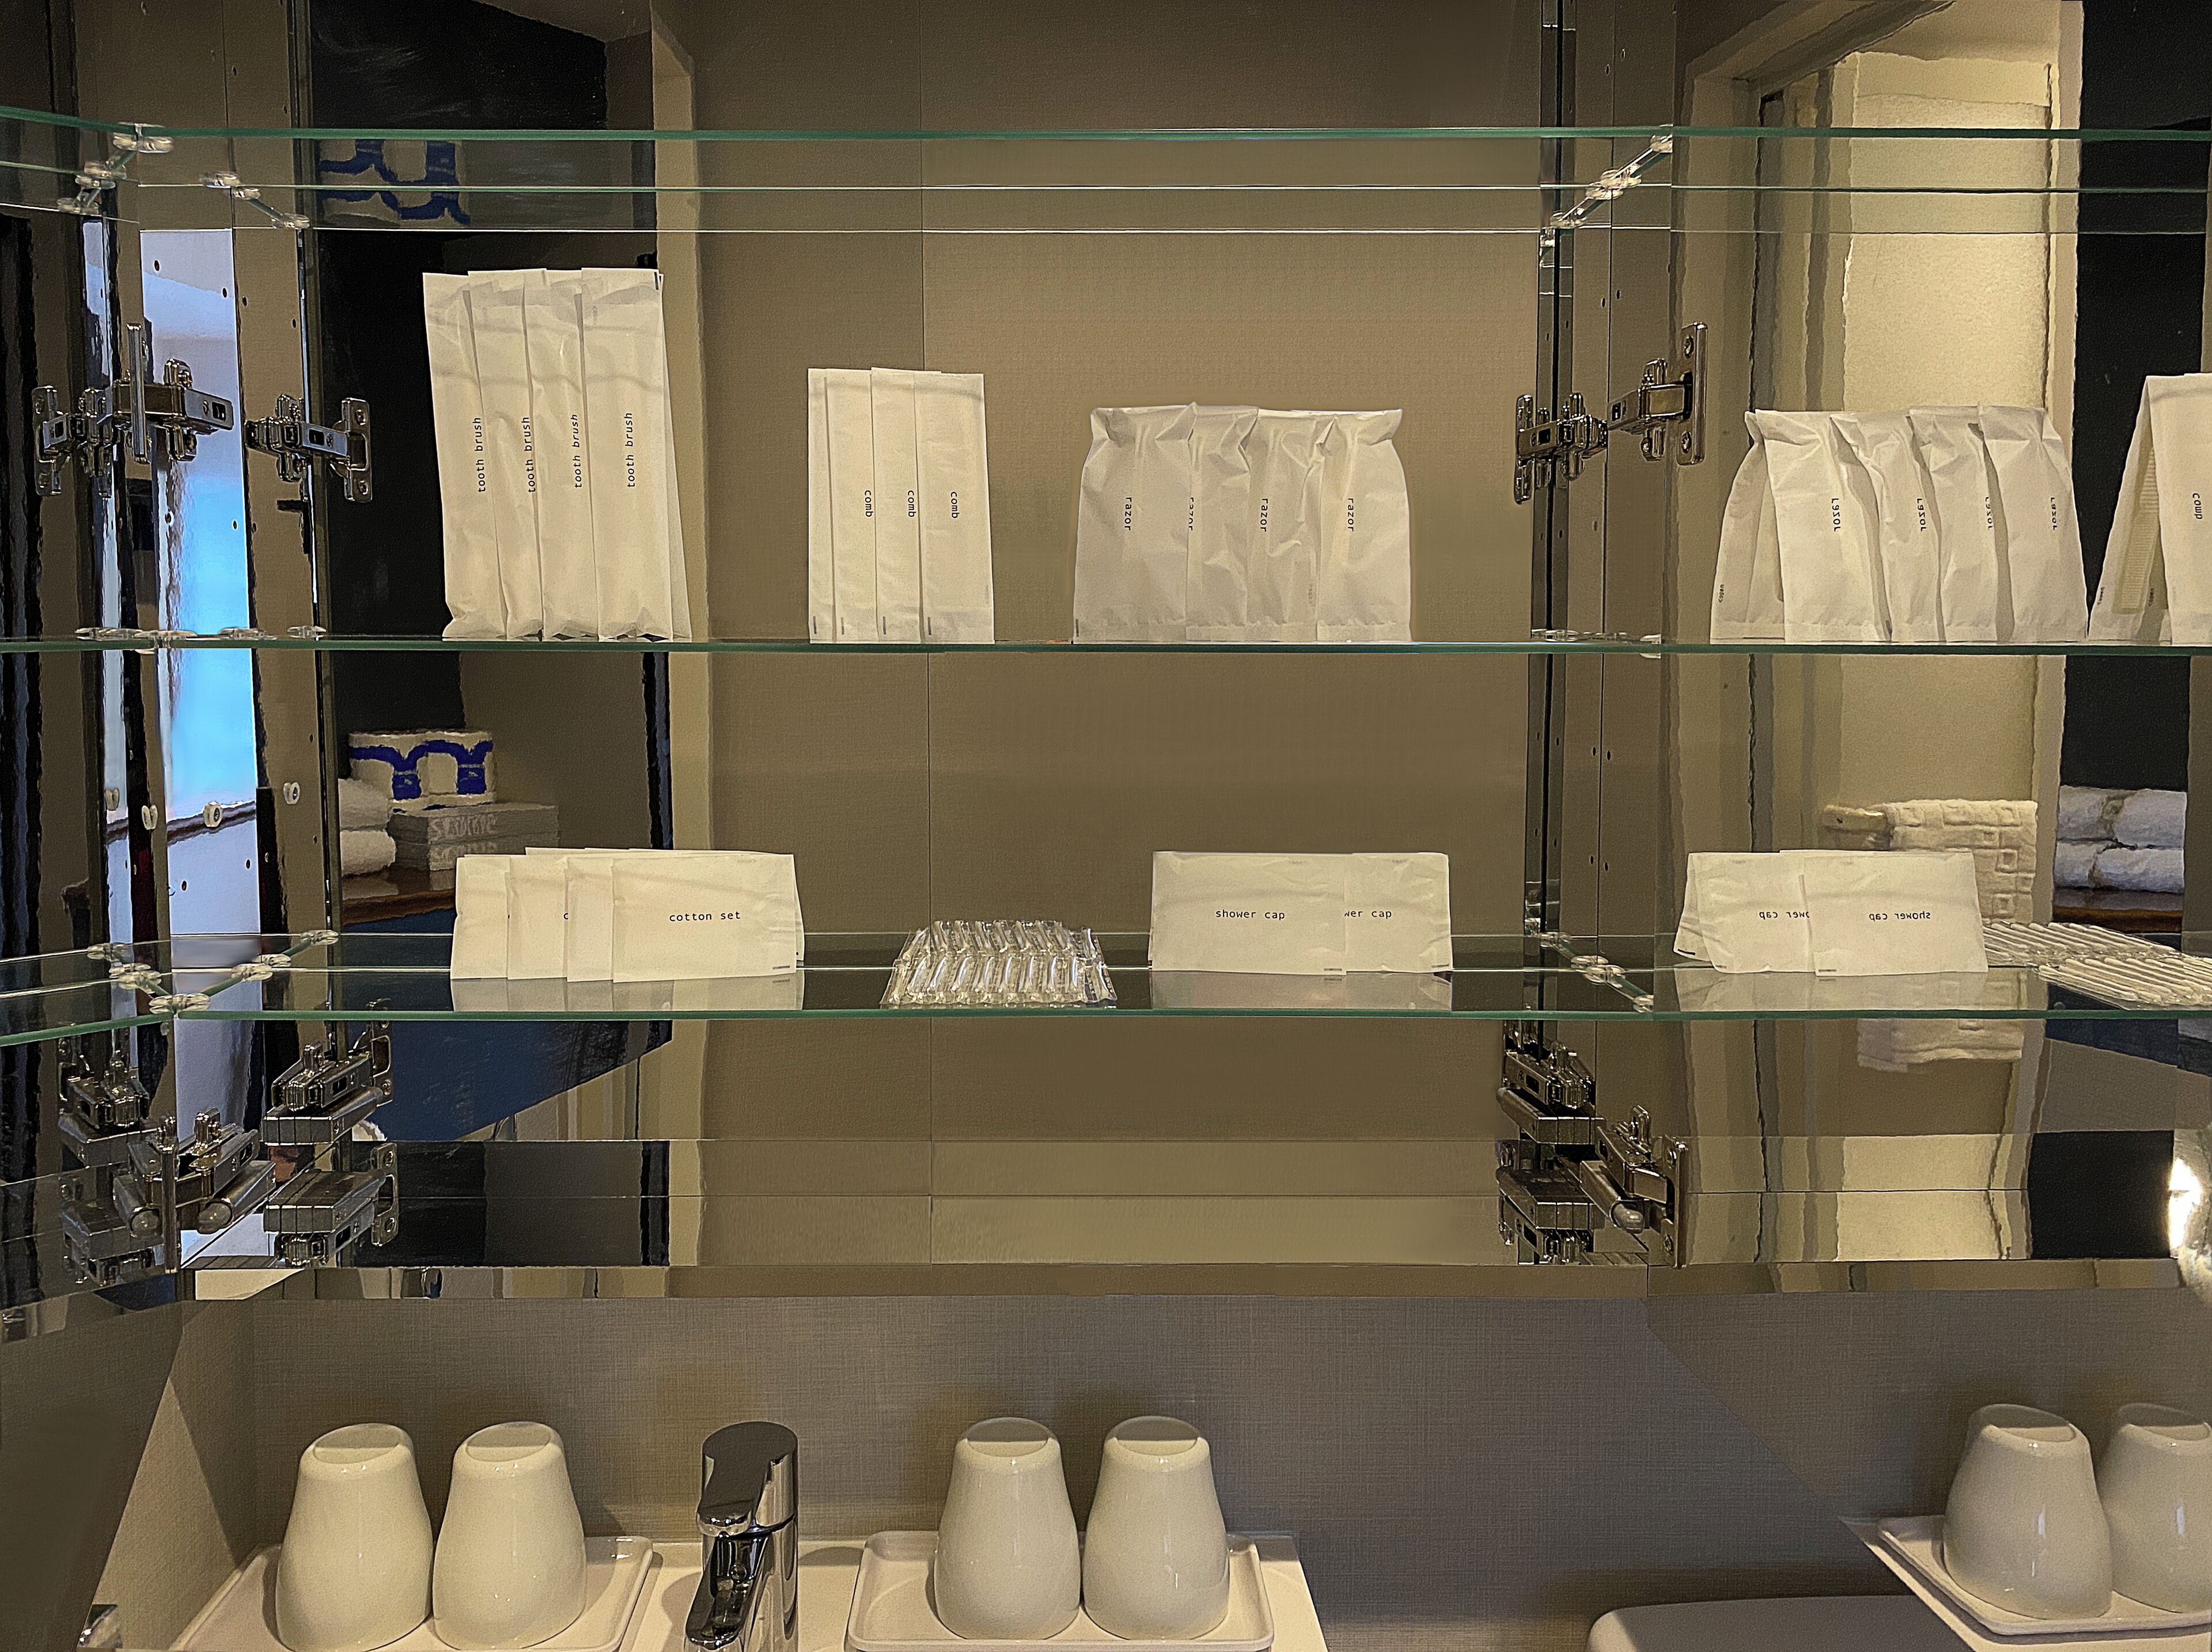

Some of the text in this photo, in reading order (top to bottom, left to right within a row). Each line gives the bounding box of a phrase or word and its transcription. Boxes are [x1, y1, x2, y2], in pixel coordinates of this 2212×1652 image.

[472, 418, 486, 492] tooth brush
[521, 417, 536, 492] tooth brush
[570, 414, 582, 488] tooth brush
[623, 413, 635, 487] tooth brush
[864, 490, 874, 517] comb
[907, 490, 916, 517] comb
[950, 491, 960, 518] comb
[1124, 497, 1132, 531] razor
[1260, 498, 1268, 532] razor
[1347, 498, 1355, 532] razor
[669, 911, 741, 922] cotton set
[1215, 909, 1285, 921] shower cap
[1371, 911, 1392, 920] cap
